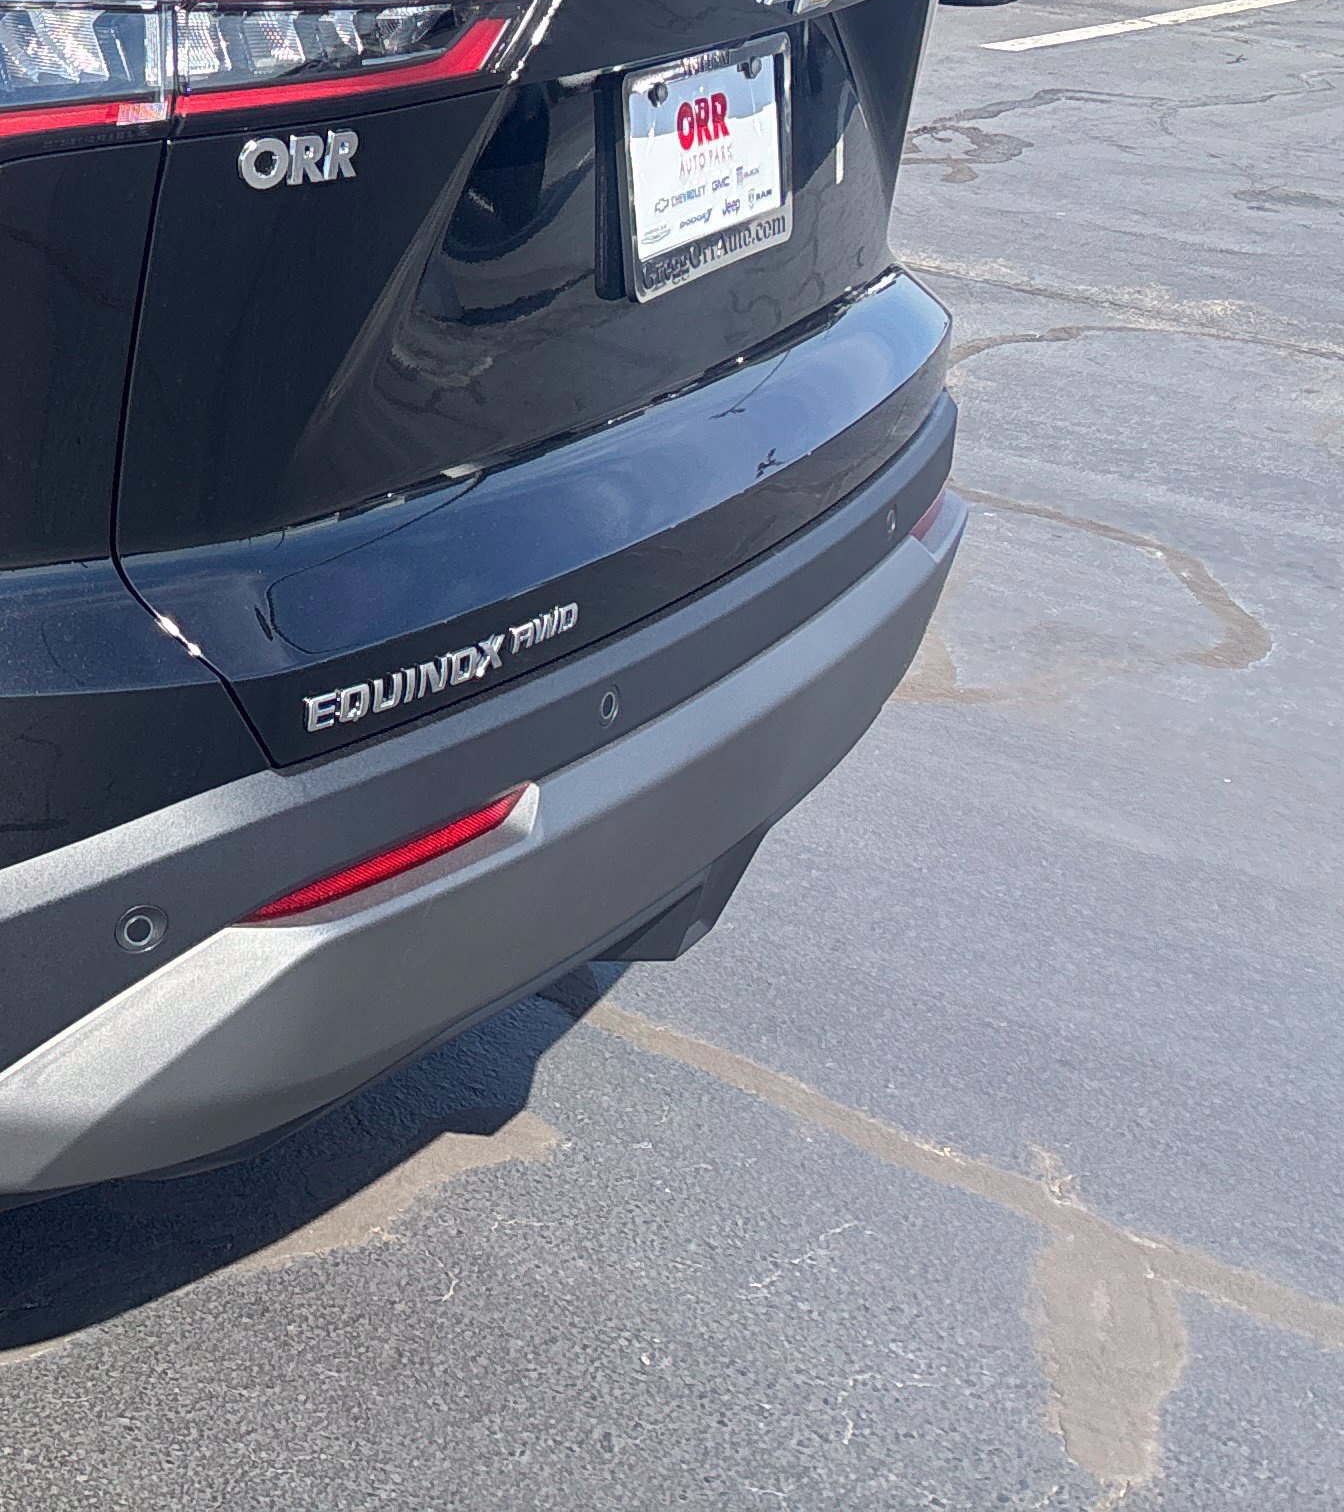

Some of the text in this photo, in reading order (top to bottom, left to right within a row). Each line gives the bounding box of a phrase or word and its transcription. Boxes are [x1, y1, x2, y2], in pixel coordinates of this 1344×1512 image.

[677, 92, 730, 150] ORR
[237, 128, 359, 190] ORR
[679, 152, 706, 178] AUTO
[303, 601, 579, 733] EQUINOX AWD
